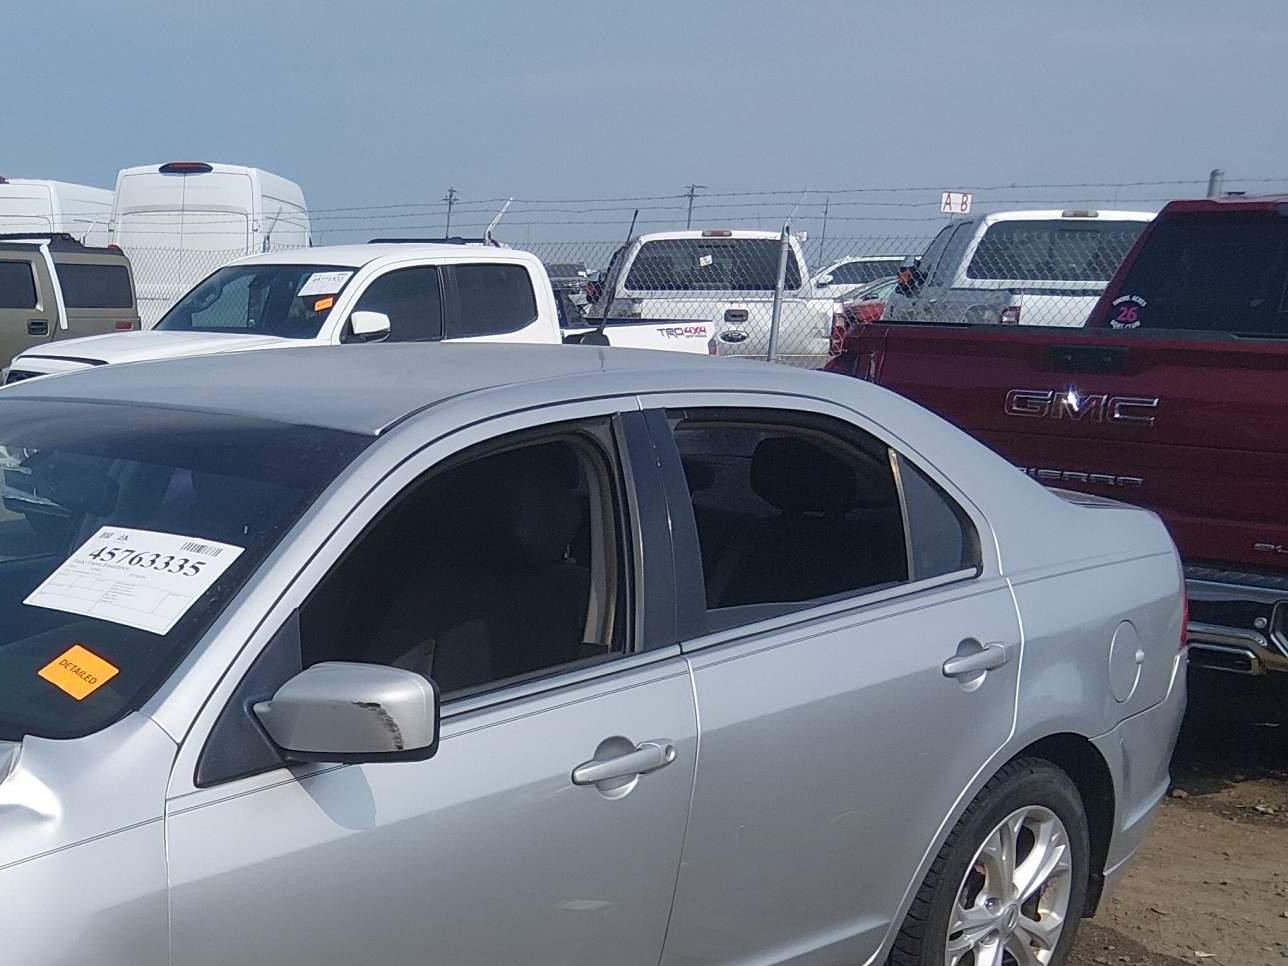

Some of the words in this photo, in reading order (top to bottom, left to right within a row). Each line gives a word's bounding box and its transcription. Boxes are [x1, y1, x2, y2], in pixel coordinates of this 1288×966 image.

[942, 193, 953, 211] A
[960, 193, 969, 212] B
[1117, 306, 1138, 322] 26
[656, 327, 684, 339] TRD
[1004, 389, 1159, 425] GMC
[88, 546, 207, 577] 45763335
[58, 658, 98, 685] DETAILED
